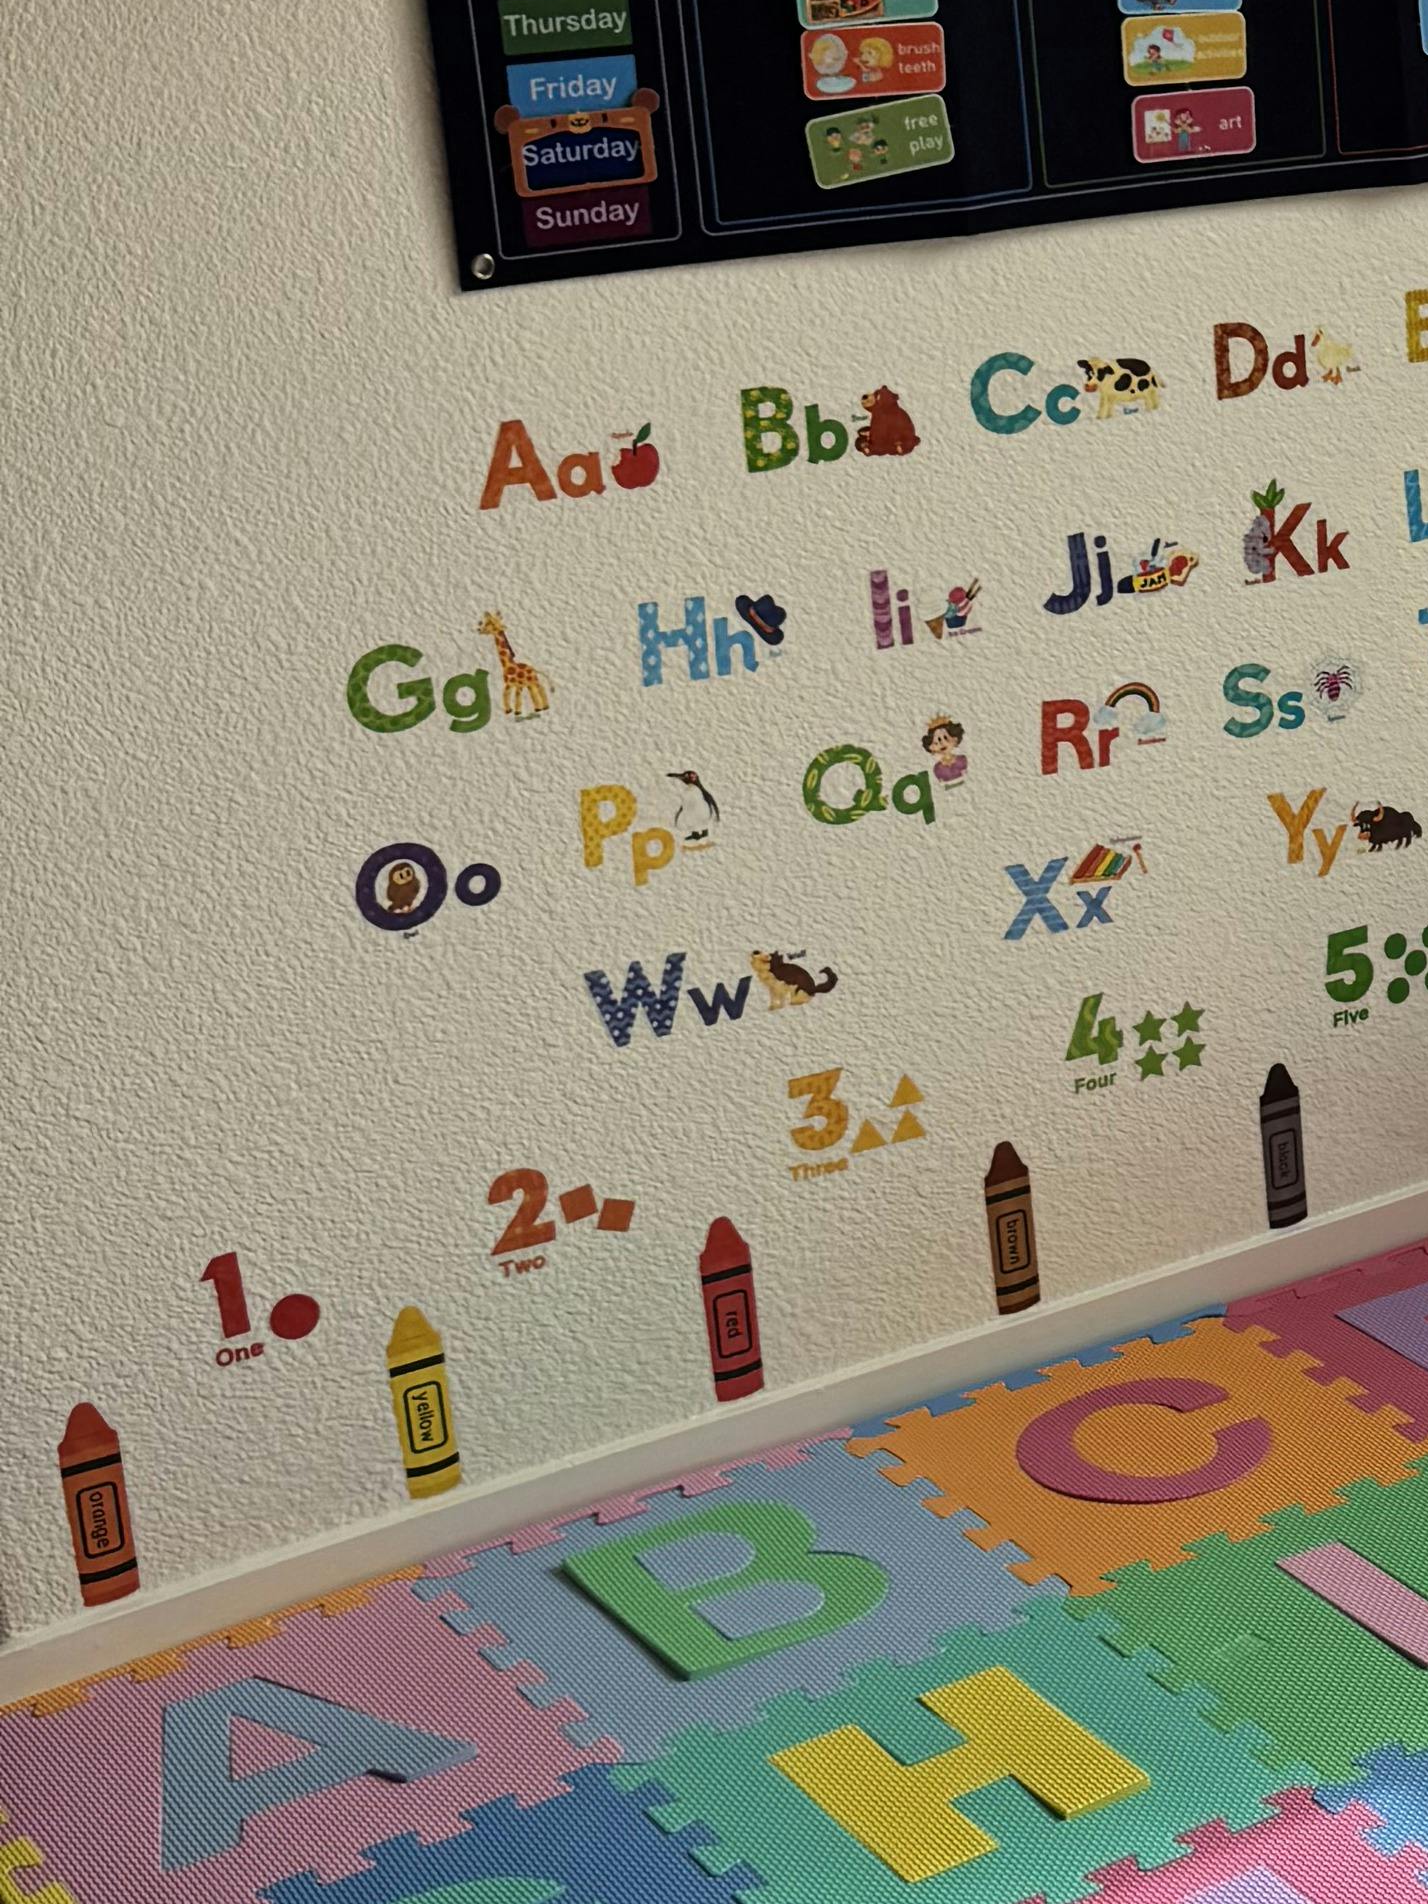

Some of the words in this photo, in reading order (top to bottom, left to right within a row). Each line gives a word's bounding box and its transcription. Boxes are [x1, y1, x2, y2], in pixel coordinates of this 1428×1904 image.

[504, 10, 626, 37] Thursday
[897, 41, 940, 57] brush
[898, 60, 936, 74] teeth
[529, 75, 617, 100] Friday
[904, 113, 938, 130] free
[1218, 114, 1242, 132] art
[522, 138, 639, 166] Saturday
[909, 133, 944, 154] play
[536, 201, 639, 228] Sunday
[1214, 321, 1309, 400] Dd
[970, 351, 1081, 435] Cc
[740, 386, 848, 472] Bb
[479, 420, 606, 510] Aa
[1139, 573, 1168, 590] JAM
[637, 596, 760, 687] Hh
[346, 644, 491, 732] Gg
[1223, 663, 1305, 739] Ss
[1004, 856, 1114, 940] Xx
[584, 952, 752, 1047] Ww
[1332, 1006, 1369, 1029] Five
[1074, 1071, 1117, 1096] Four
[789, 1158, 849, 1182] Three
[1004, 1219, 1022, 1265] brown
[499, 1255, 546, 1277] Two
[725, 1310, 741, 1340] red
[215, 1341, 265, 1367] One
[411, 1391, 435, 1444] yellow
[89, 1491, 111, 1548] orange
[562, 1502, 891, 1682] B
[156, 1676, 475, 1872] A
[770, 1667, 1152, 1884] H
